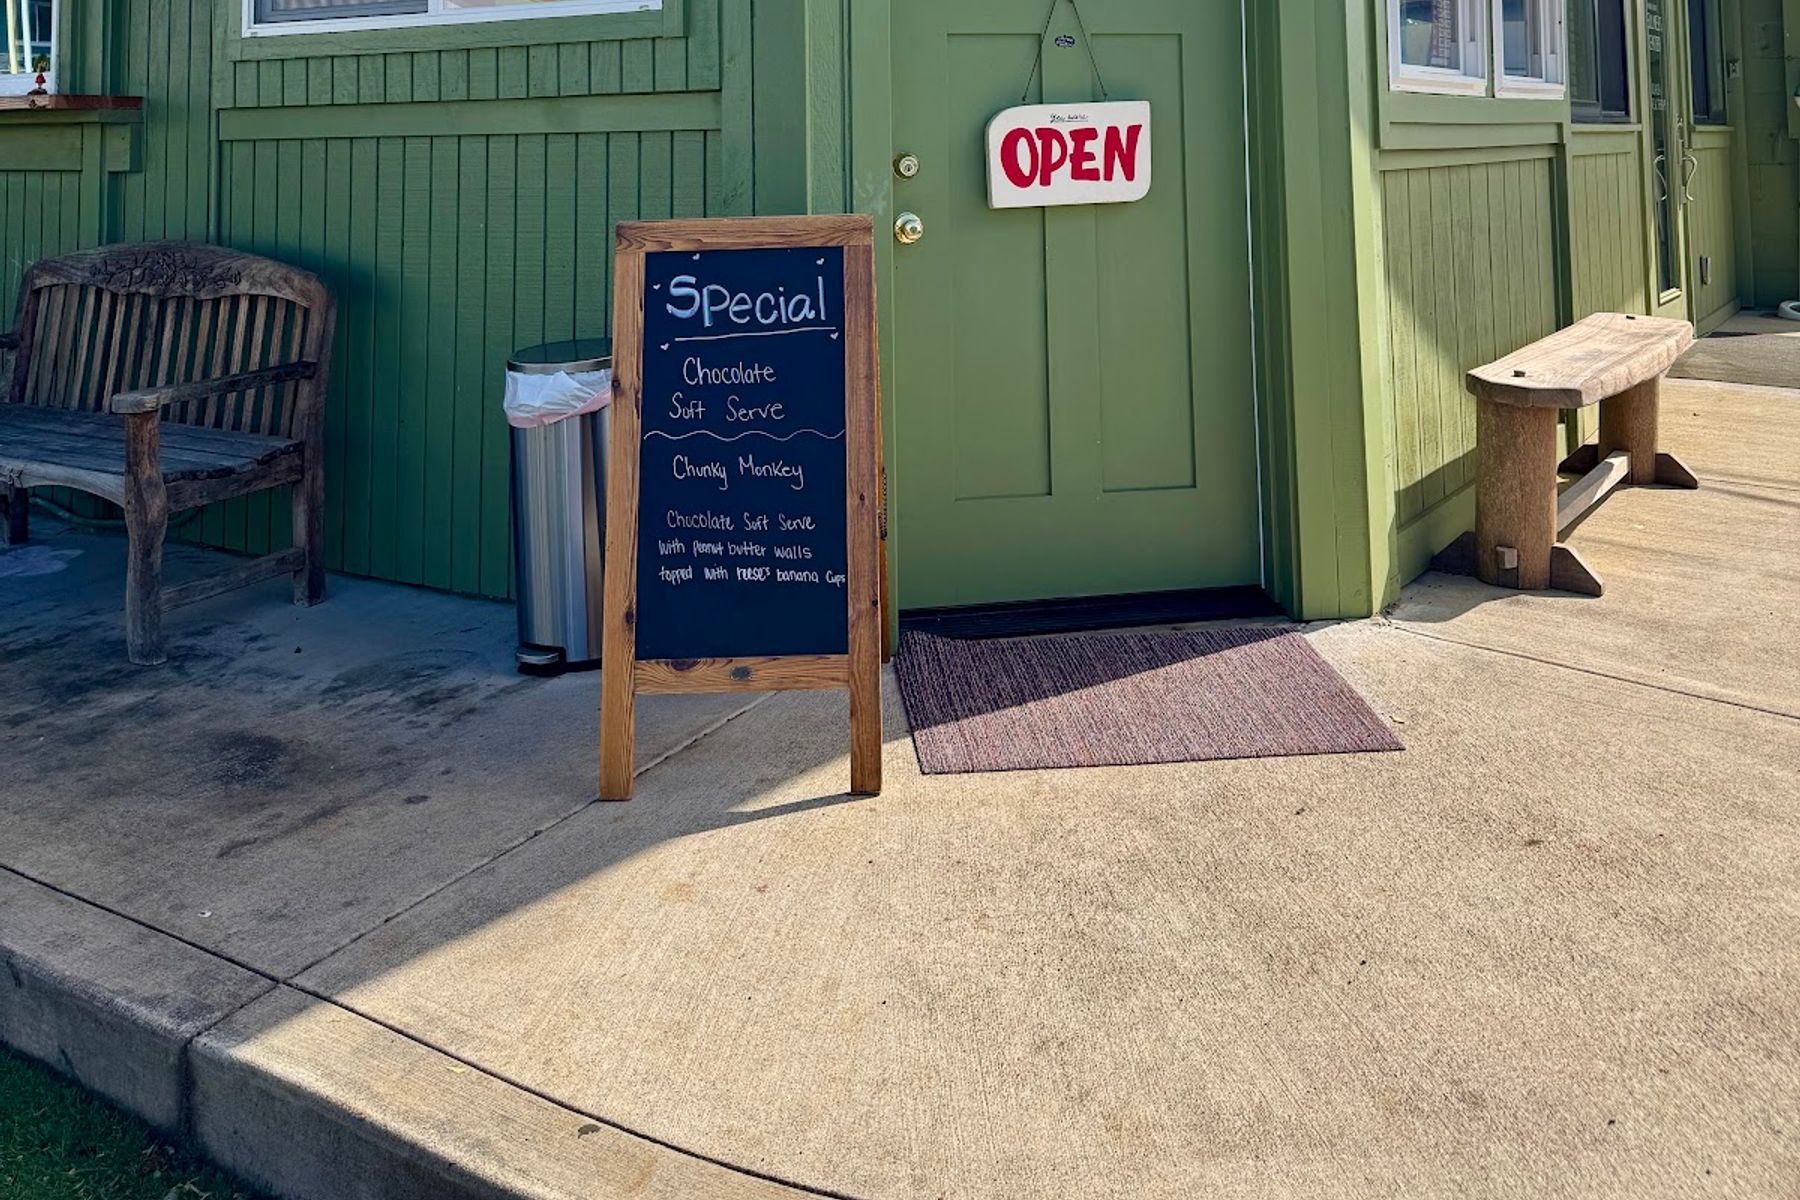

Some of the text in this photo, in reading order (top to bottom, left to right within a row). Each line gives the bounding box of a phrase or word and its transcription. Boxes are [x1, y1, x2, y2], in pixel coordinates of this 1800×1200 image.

[1000, 124, 1143, 188] OPEN
[666, 275, 826, 327] Special
[682, 357, 777, 385] Chocolate
[669, 392, 785, 421] Soft Serve
[673, 453, 804, 490] Chunky Monkey
[666, 510, 816, 531] Chocolate Soft Serve
[727, 541, 767, 557] butter
[774, 545, 813, 560] walls
[659, 565, 693, 585] topped
[703, 563, 729, 580] with
[776, 569, 820, 583] banana
